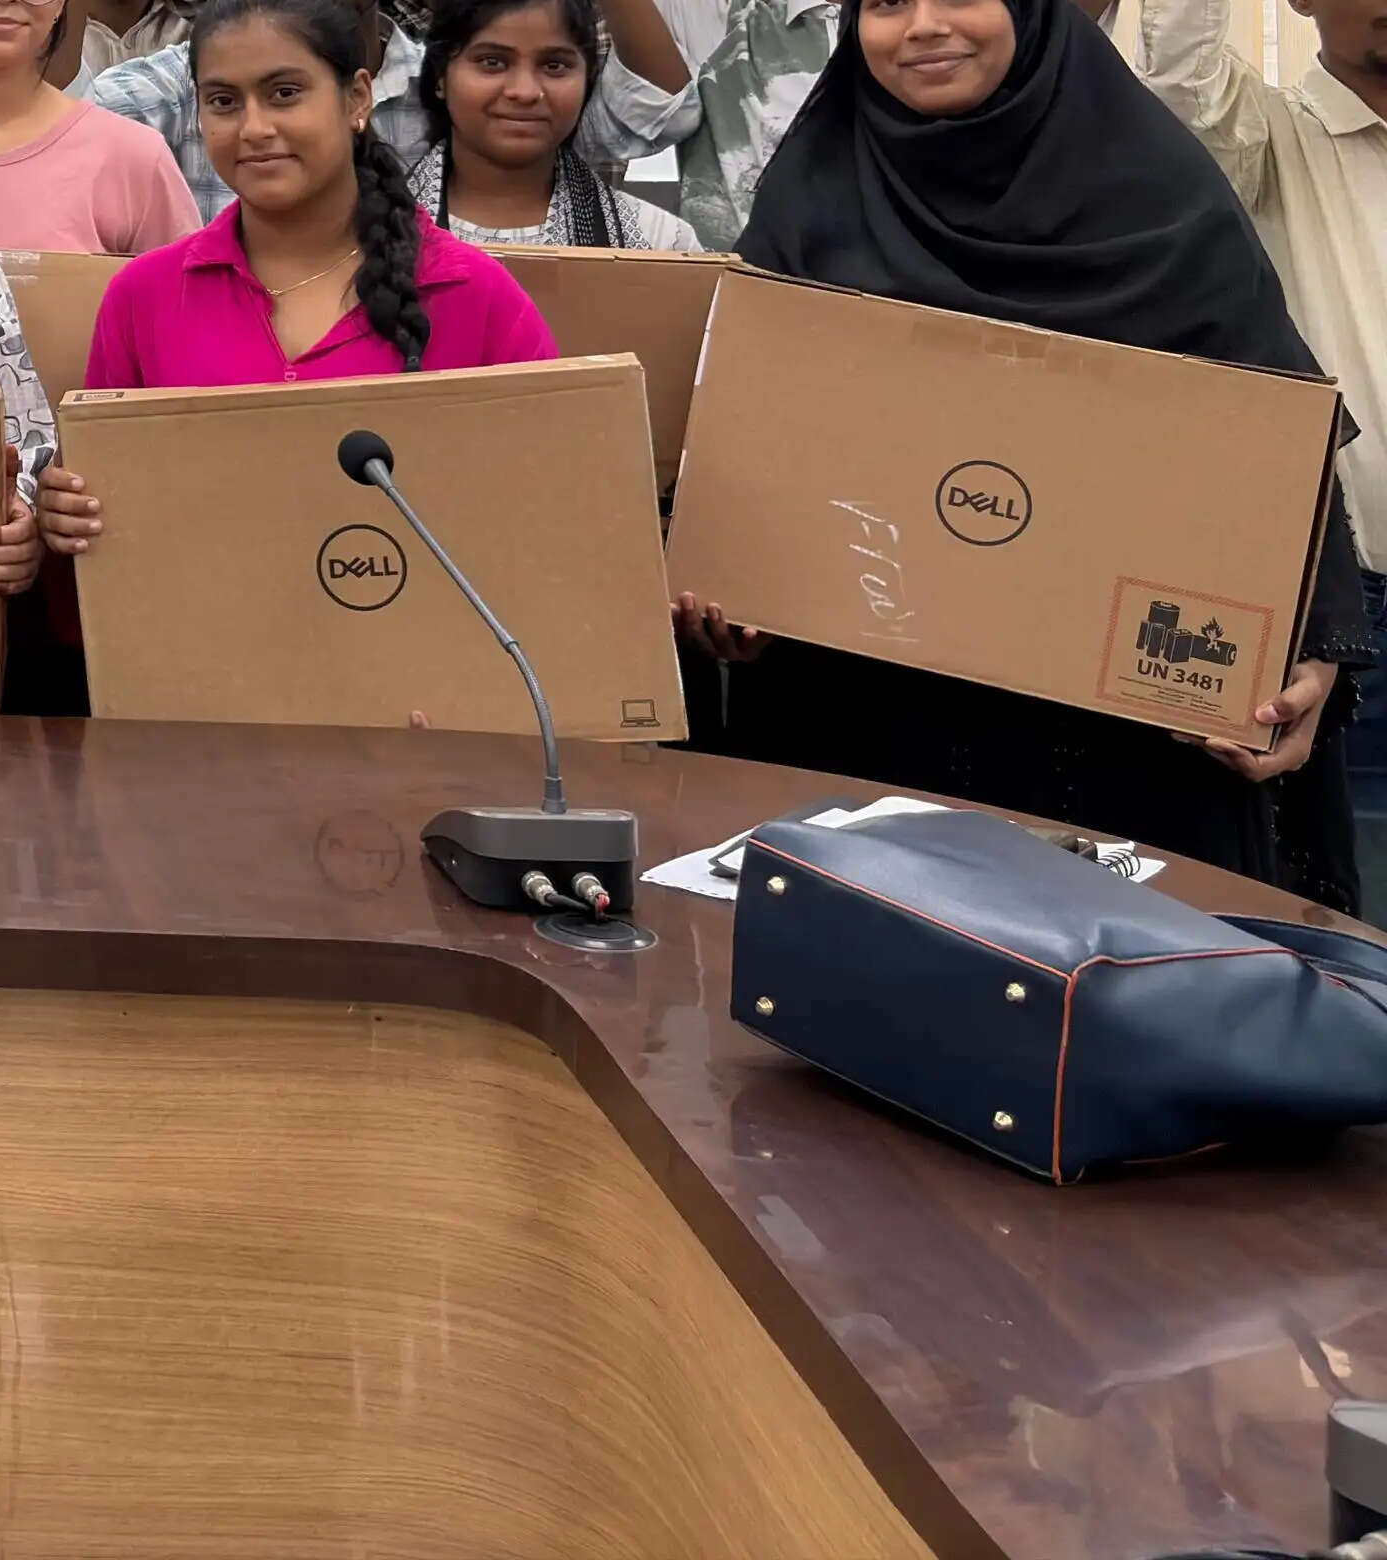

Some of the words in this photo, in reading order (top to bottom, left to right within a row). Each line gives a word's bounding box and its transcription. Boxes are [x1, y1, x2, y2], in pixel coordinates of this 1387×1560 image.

[947, 486, 1021, 522] DELL
[328, 556, 399, 580] DELL
[1137, 659, 1169, 681] UN
[1172, 668, 1224, 694] 3481
